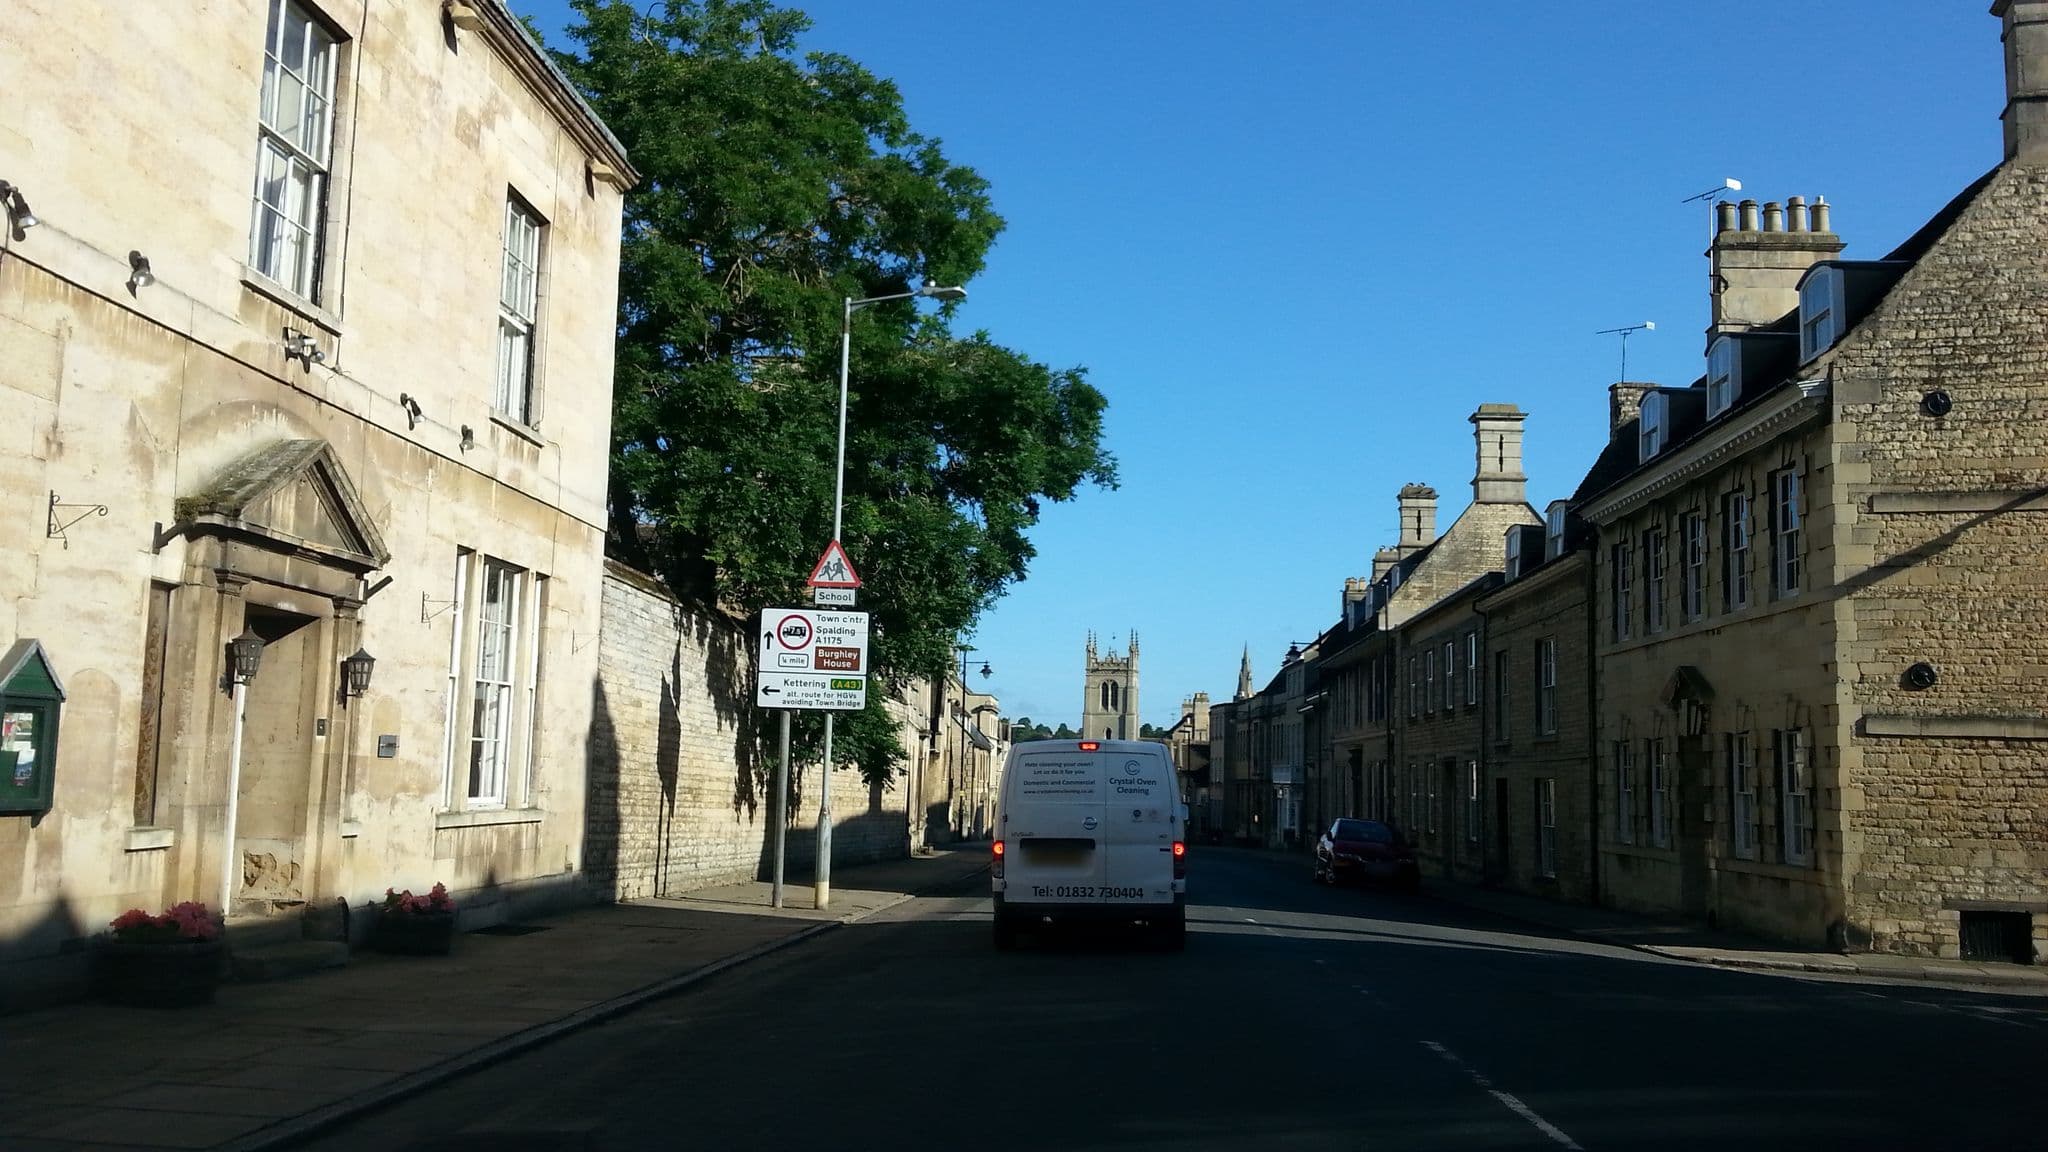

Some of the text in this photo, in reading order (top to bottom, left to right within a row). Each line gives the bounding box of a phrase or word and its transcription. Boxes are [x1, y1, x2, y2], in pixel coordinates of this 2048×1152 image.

[818, 592, 852, 602] School
[816, 614, 840, 623] Town
[816, 626, 856, 636] Spalding
[818, 649, 858, 659] Burghley
[789, 656, 804, 664] mile
[824, 659, 852, 668] House
[784, 679, 826, 689] Kettering
[837, 700, 860, 708] Bridge
[1109, 777, 1157, 786] Crystal Oven
[1116, 787, 1150, 796] Cleaning
[1032, 886, 1053, 898] Tel:
[1056, 886, 1094, 898] 01832
[1098, 887, 1144, 898] 730404
